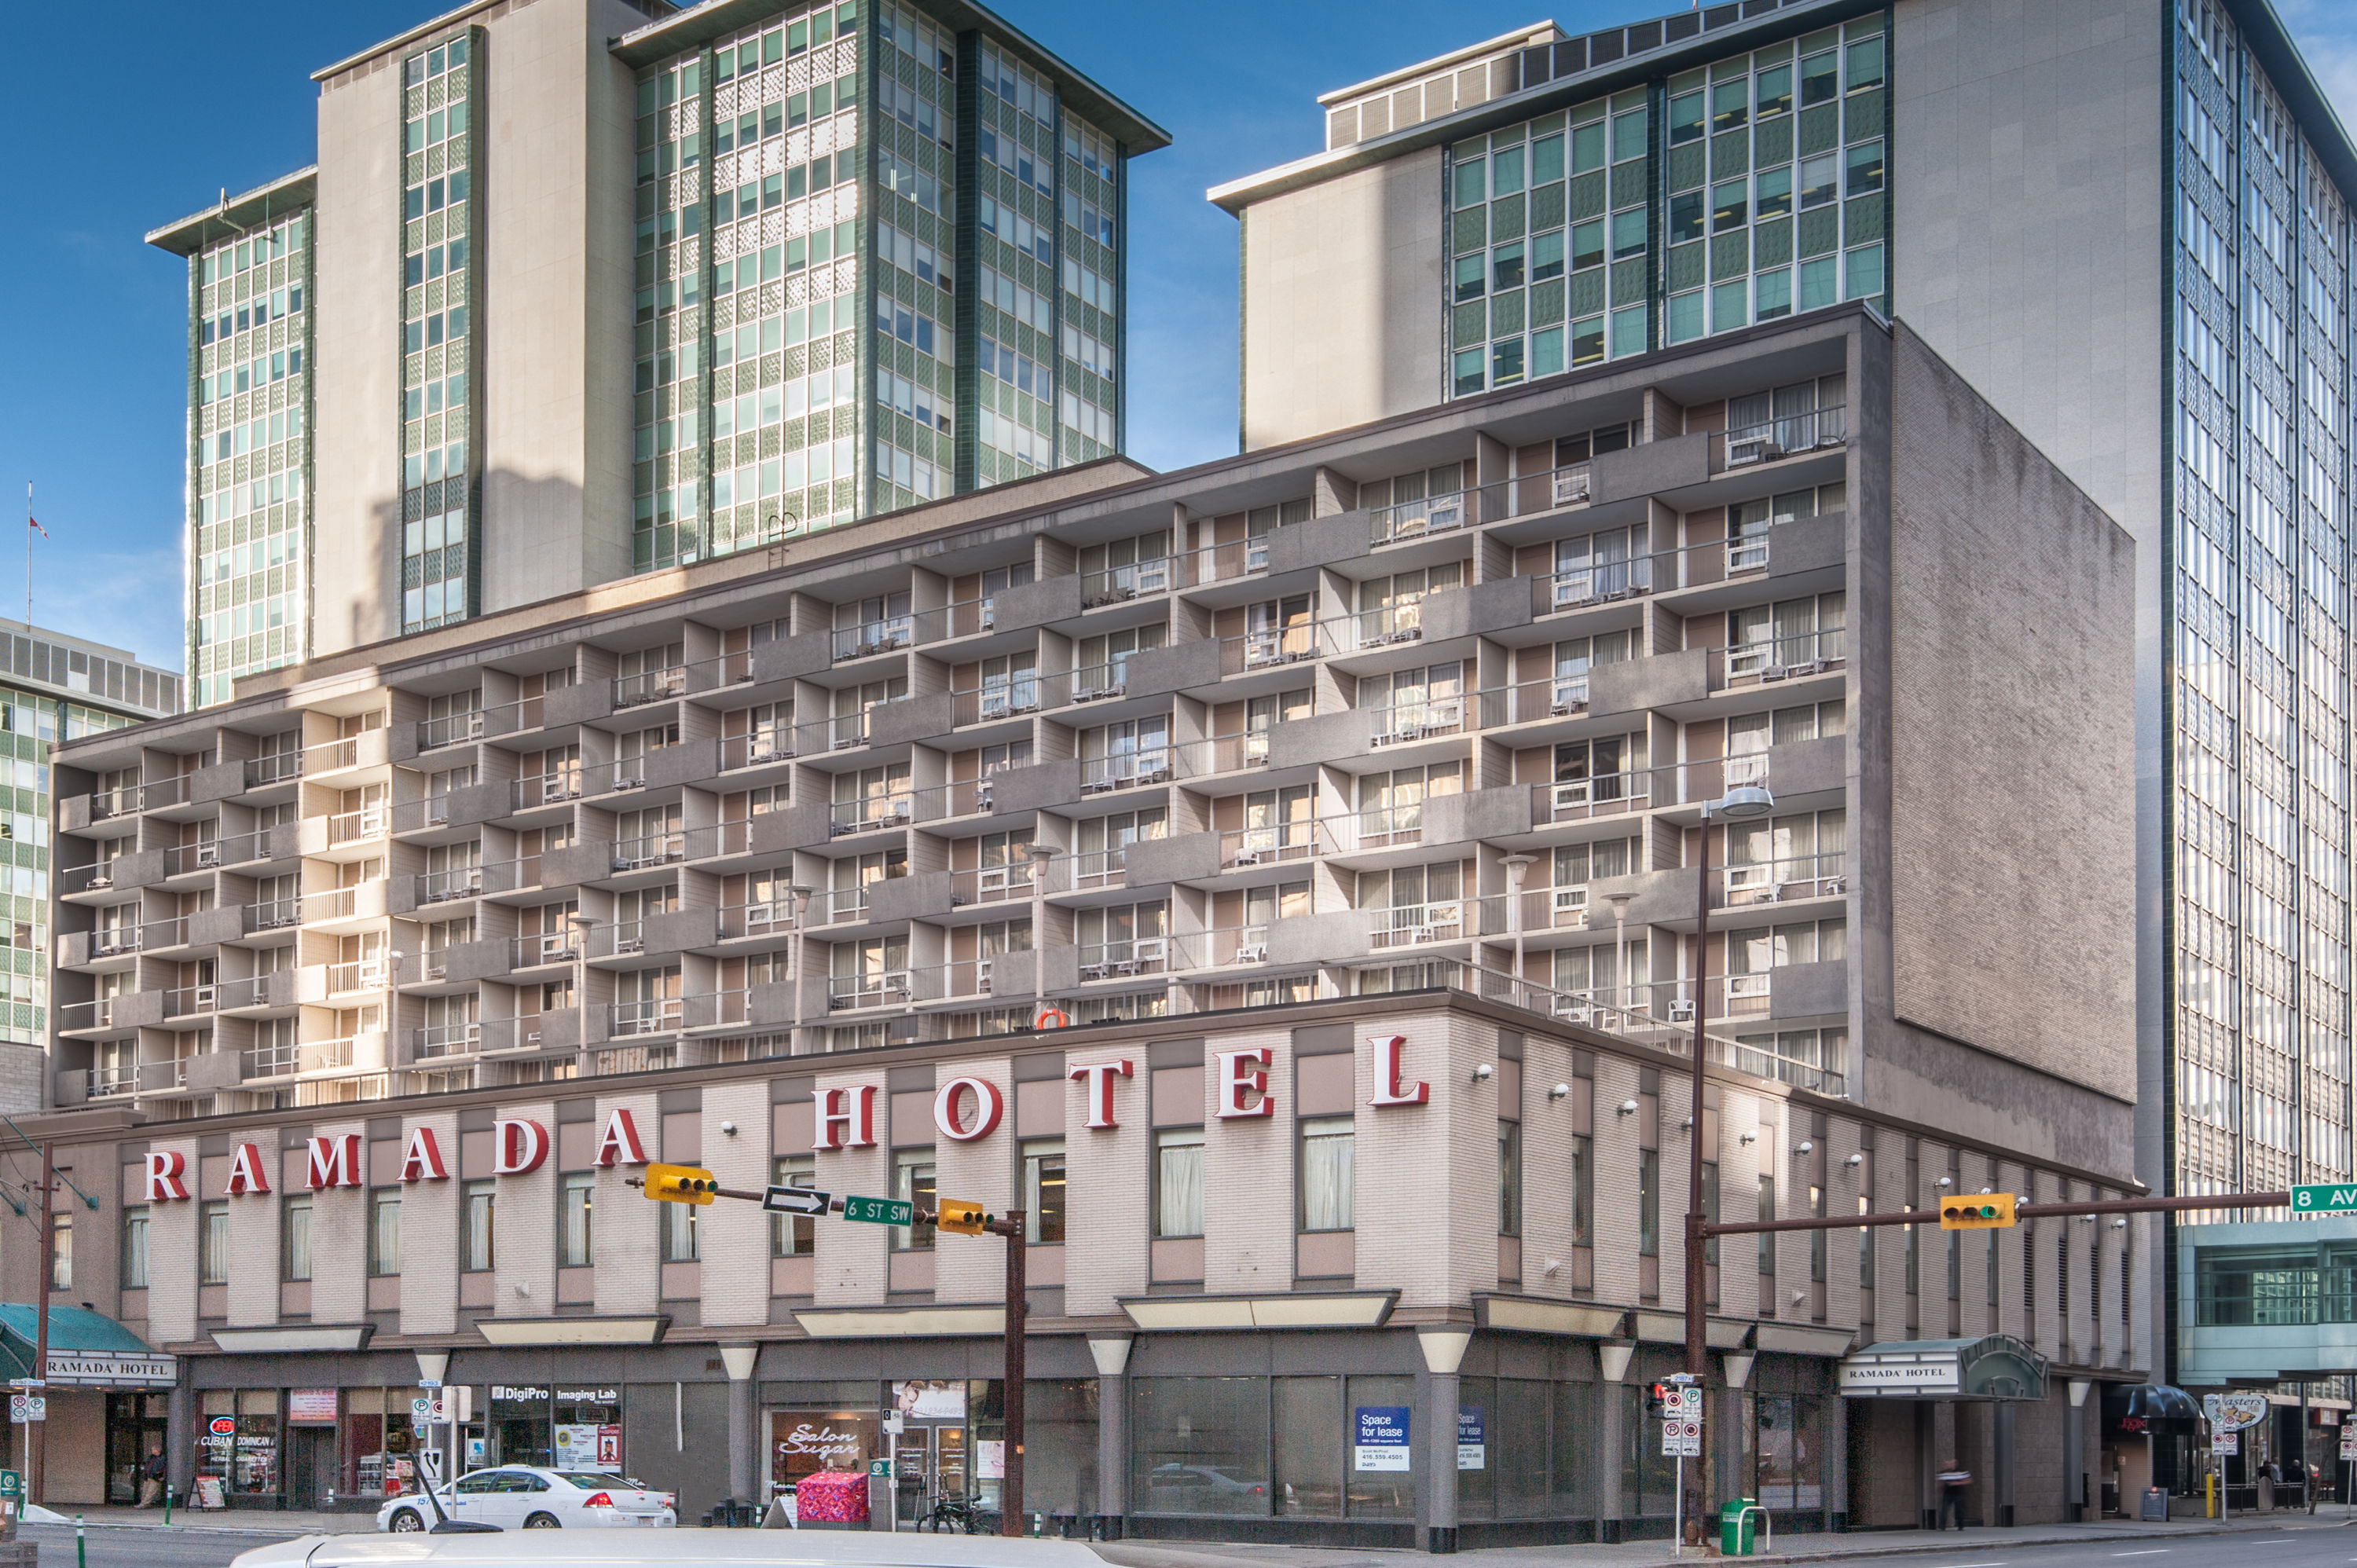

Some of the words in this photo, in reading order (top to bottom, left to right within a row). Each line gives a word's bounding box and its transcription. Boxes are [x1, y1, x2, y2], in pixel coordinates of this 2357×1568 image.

[143, 1108, 650, 1202] RAMADA
[810, 1035, 1429, 1150] HOTEL
[2298, 1191, 2311, 1207] 8
[2330, 1189, 2357, 1205] AV
[849, 1202, 857, 1216] 6
[867, 1203, 884, 1218] ST
[890, 1205, 910, 1221] SW
[47, 1361, 112, 1373] RAMADA
[120, 1364, 168, 1375] HOTEL
[1849, 1369, 1901, 1378] RAMADA
[505, 1387, 548, 1402] DigiPro
[557, 1390, 596, 1401] Imaging
[598, 1390, 617, 1399] Lab
[1362, 1414, 1391, 1427] Space
[1458, 1413, 1475, 1423] Space
[788, 1423, 856, 1442] Salon
[1362, 1427, 1376, 1436] for
[1377, 1427, 1403, 1436] lease
[1468, 1426, 1481, 1435] lease
[201, 1437, 233, 1445] CUBAN
[237, 1437, 269, 1445] DOMINICAN
[779, 1436, 860, 1460] Sugar
[416, 1497, 431, 1505] 157
